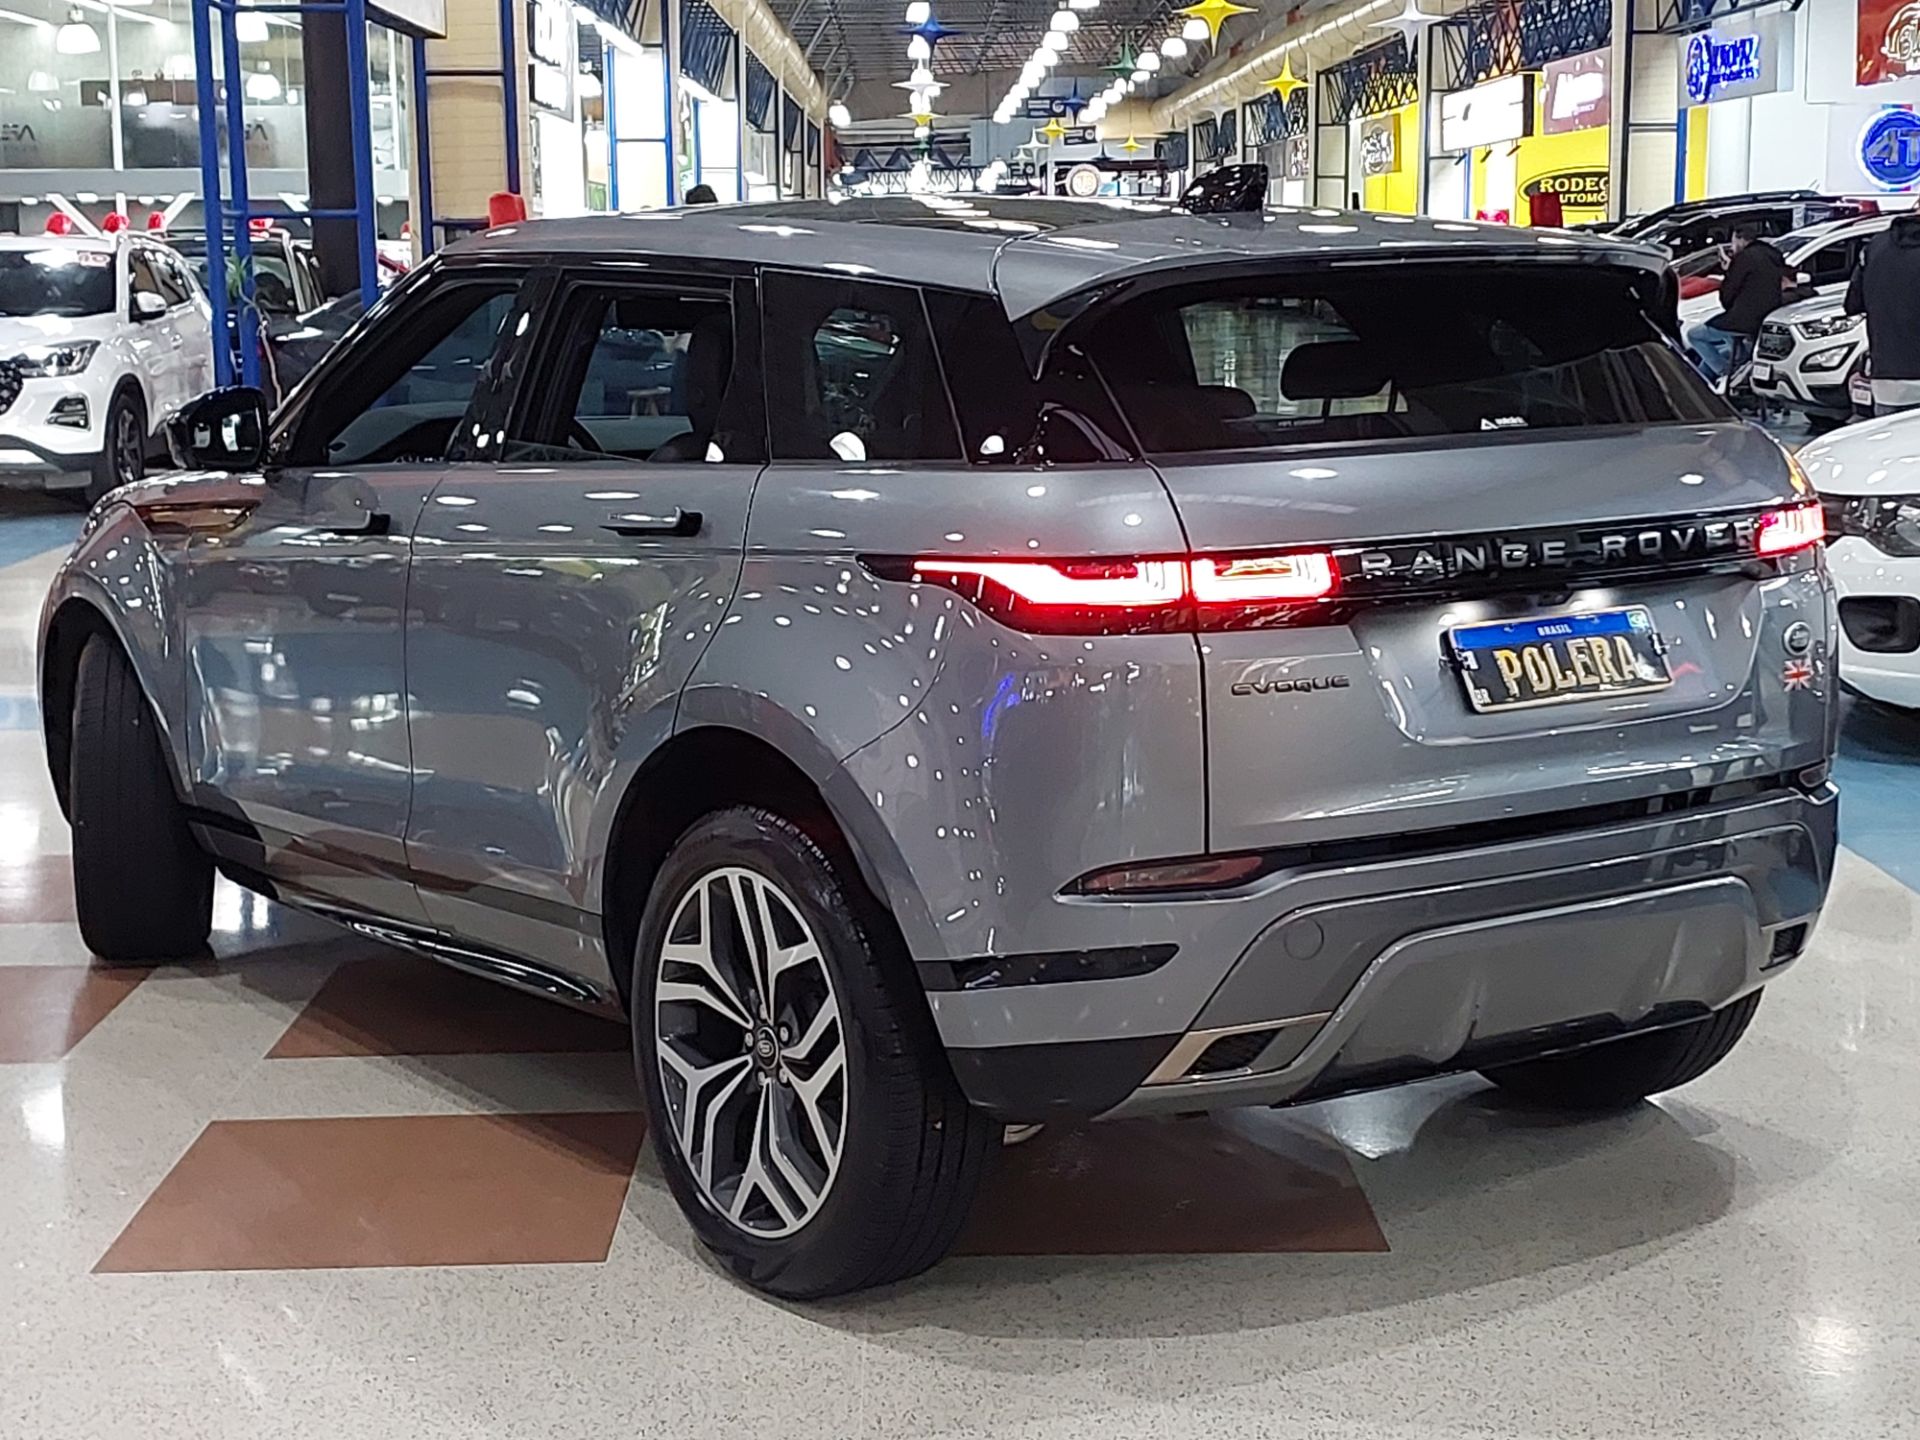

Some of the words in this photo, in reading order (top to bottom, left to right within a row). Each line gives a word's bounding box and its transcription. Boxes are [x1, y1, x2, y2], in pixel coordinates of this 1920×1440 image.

[1361, 541, 1567, 575] RANGE
[1601, 521, 1756, 561] ROVER
[1537, 623, 1573, 637] BRASIL
[1492, 635, 1641, 698] POLERA
[1230, 675, 1351, 697] EVOQUE
